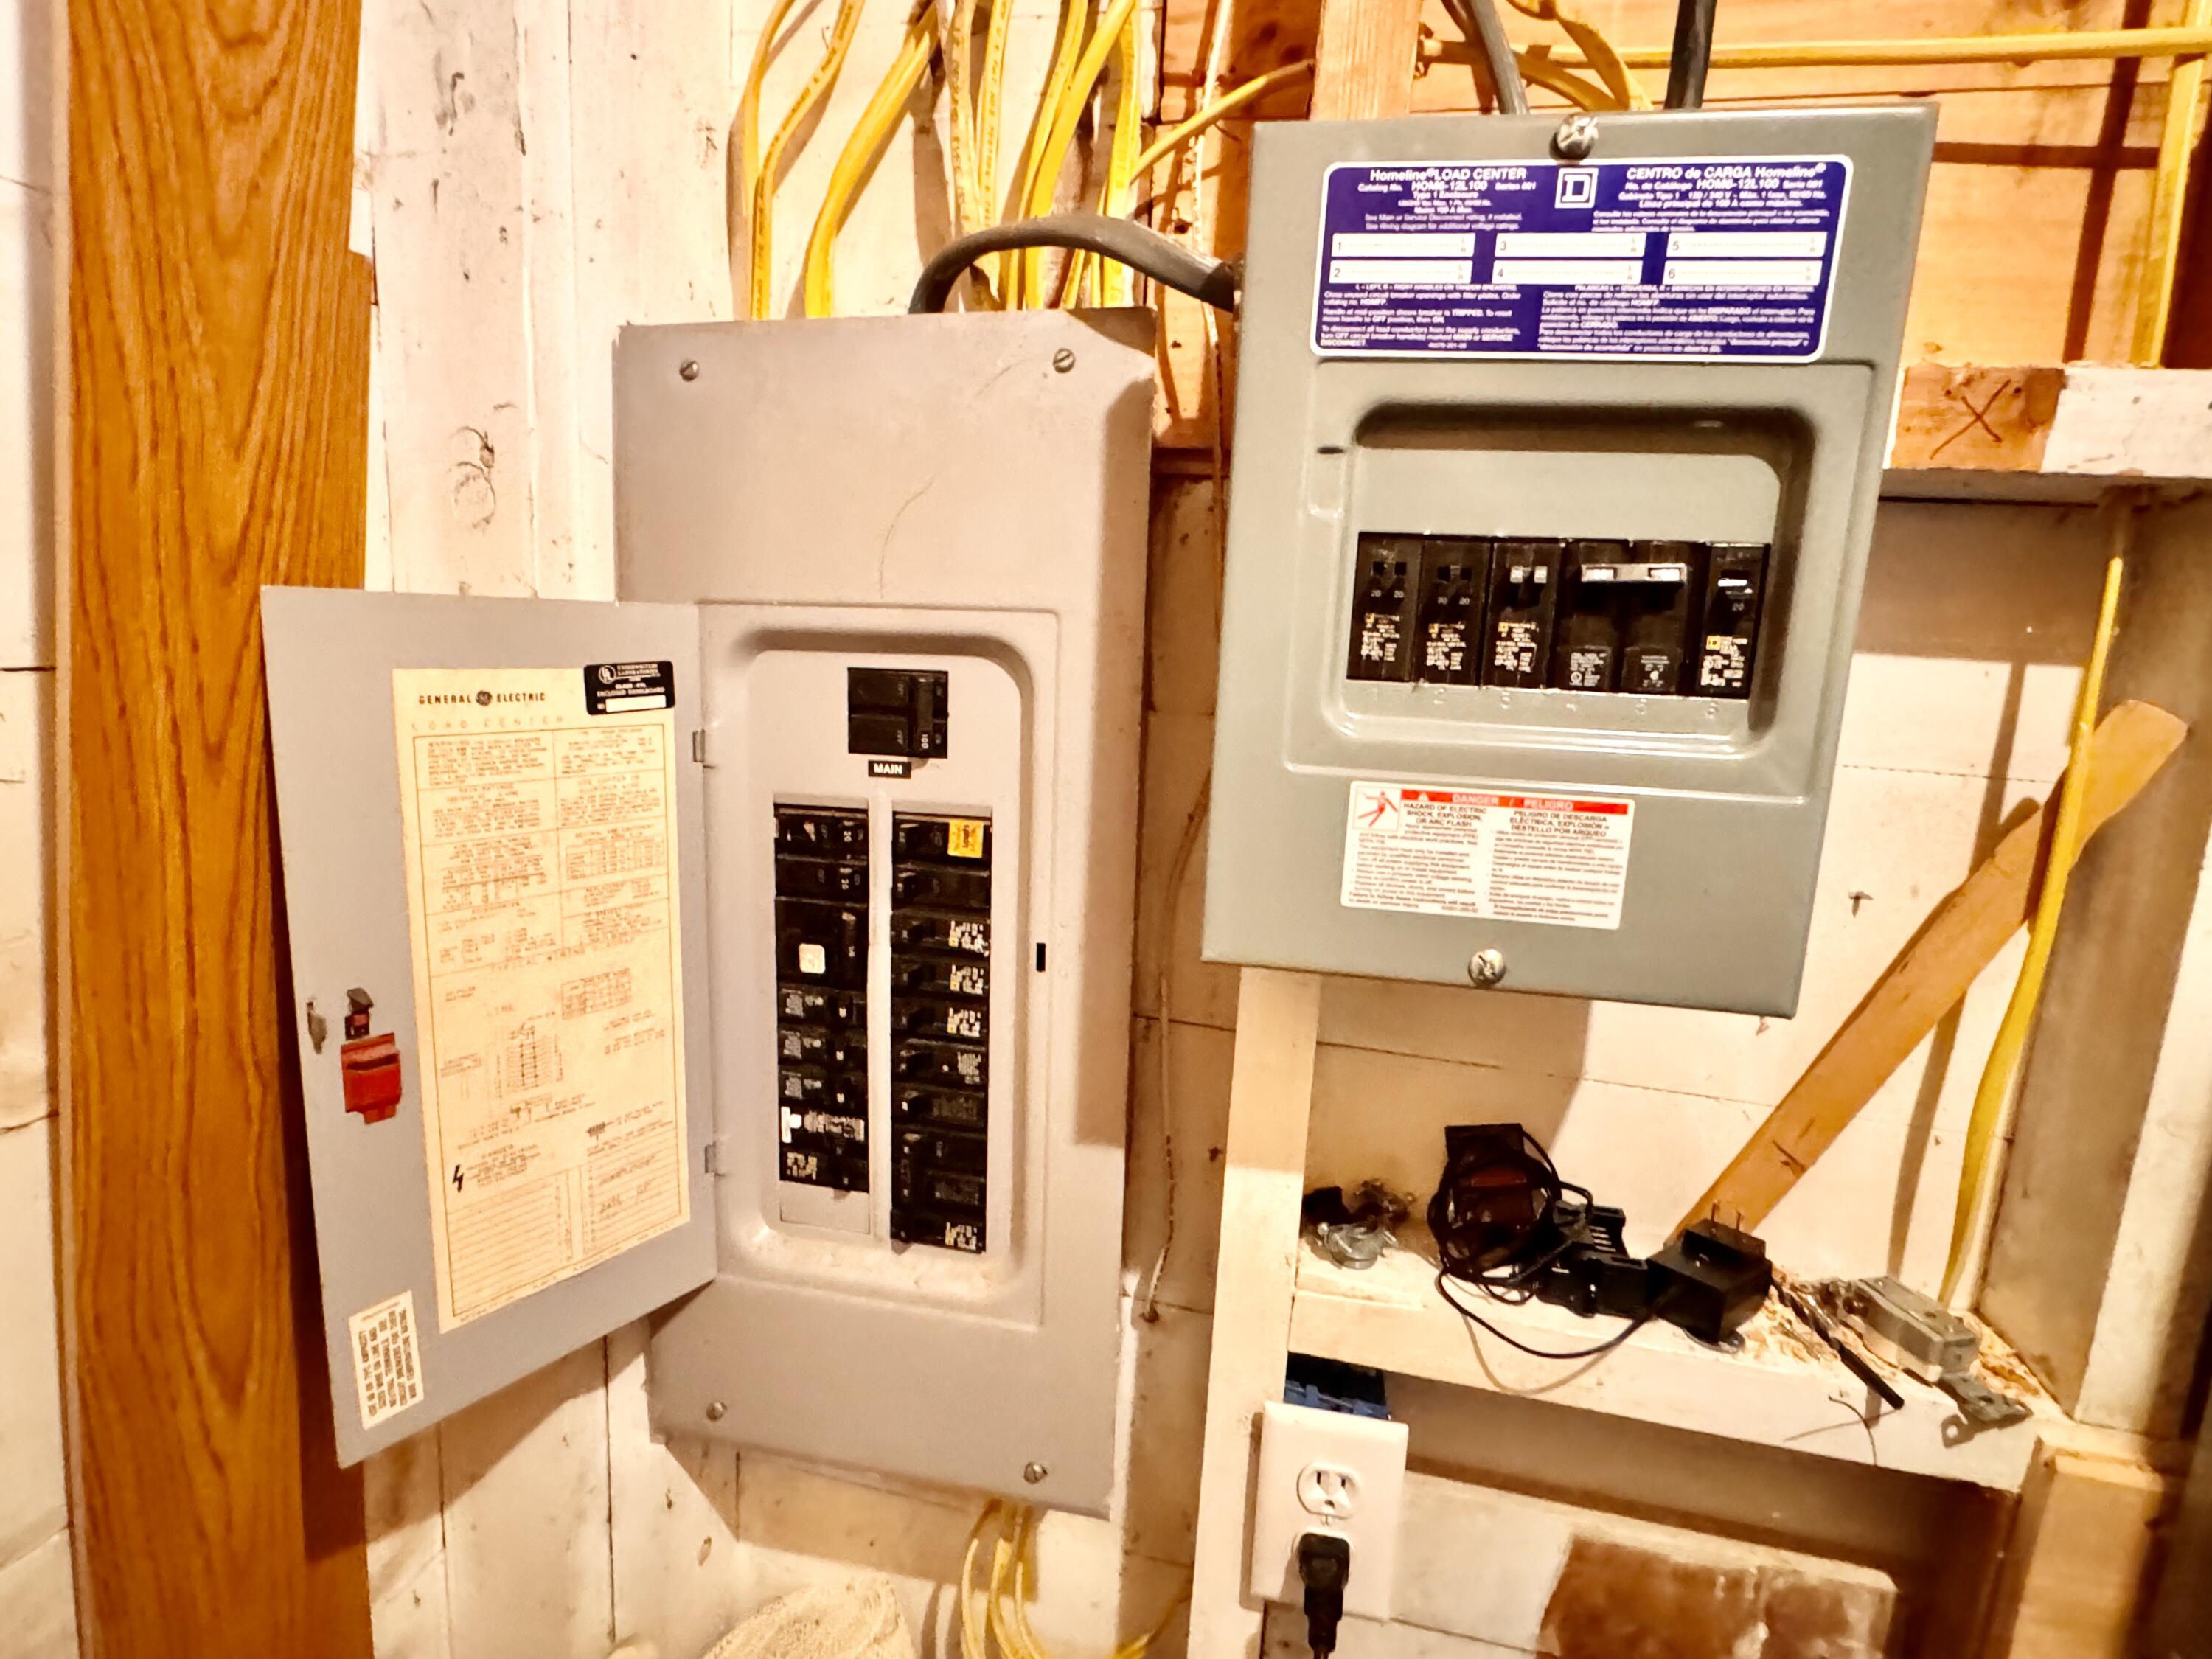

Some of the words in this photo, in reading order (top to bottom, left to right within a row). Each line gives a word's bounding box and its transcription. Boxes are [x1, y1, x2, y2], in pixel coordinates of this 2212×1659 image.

[1435, 168, 1470, 180] LOAD
[1472, 167, 1527, 180] CENTER
[1627, 167, 1683, 180] CENTRO
[1685, 167, 1702, 179] de
[1704, 166, 1751, 178] CARGA
[1338, 242, 1341, 250] 1
[1500, 241, 1507, 251] 3
[1672, 241, 1680, 251] 5
[1334, 268, 1340, 277] 2
[1497, 268, 1504, 278] 4
[1668, 268, 1675, 279] 6
[419, 695, 472, 705] GENERAL
[496, 692, 545, 703] ELECTRIC
[874, 762, 903, 775] MAIN
[1452, 793, 1499, 805] DANGER
[1523, 798, 1574, 811] PELIGRO
[1404, 803, 1435, 811] HAZARD
[1450, 805, 1487, 815] ELECTRIC
[1514, 810, 1548, 818] PELIGRO
[1563, 813, 1607, 822] DESCARGA
[1447, 818, 1472, 827] FLASH
[1512, 824, 1551, 833] DESTELLO
[1572, 828, 1607, 838] ARQUEO
